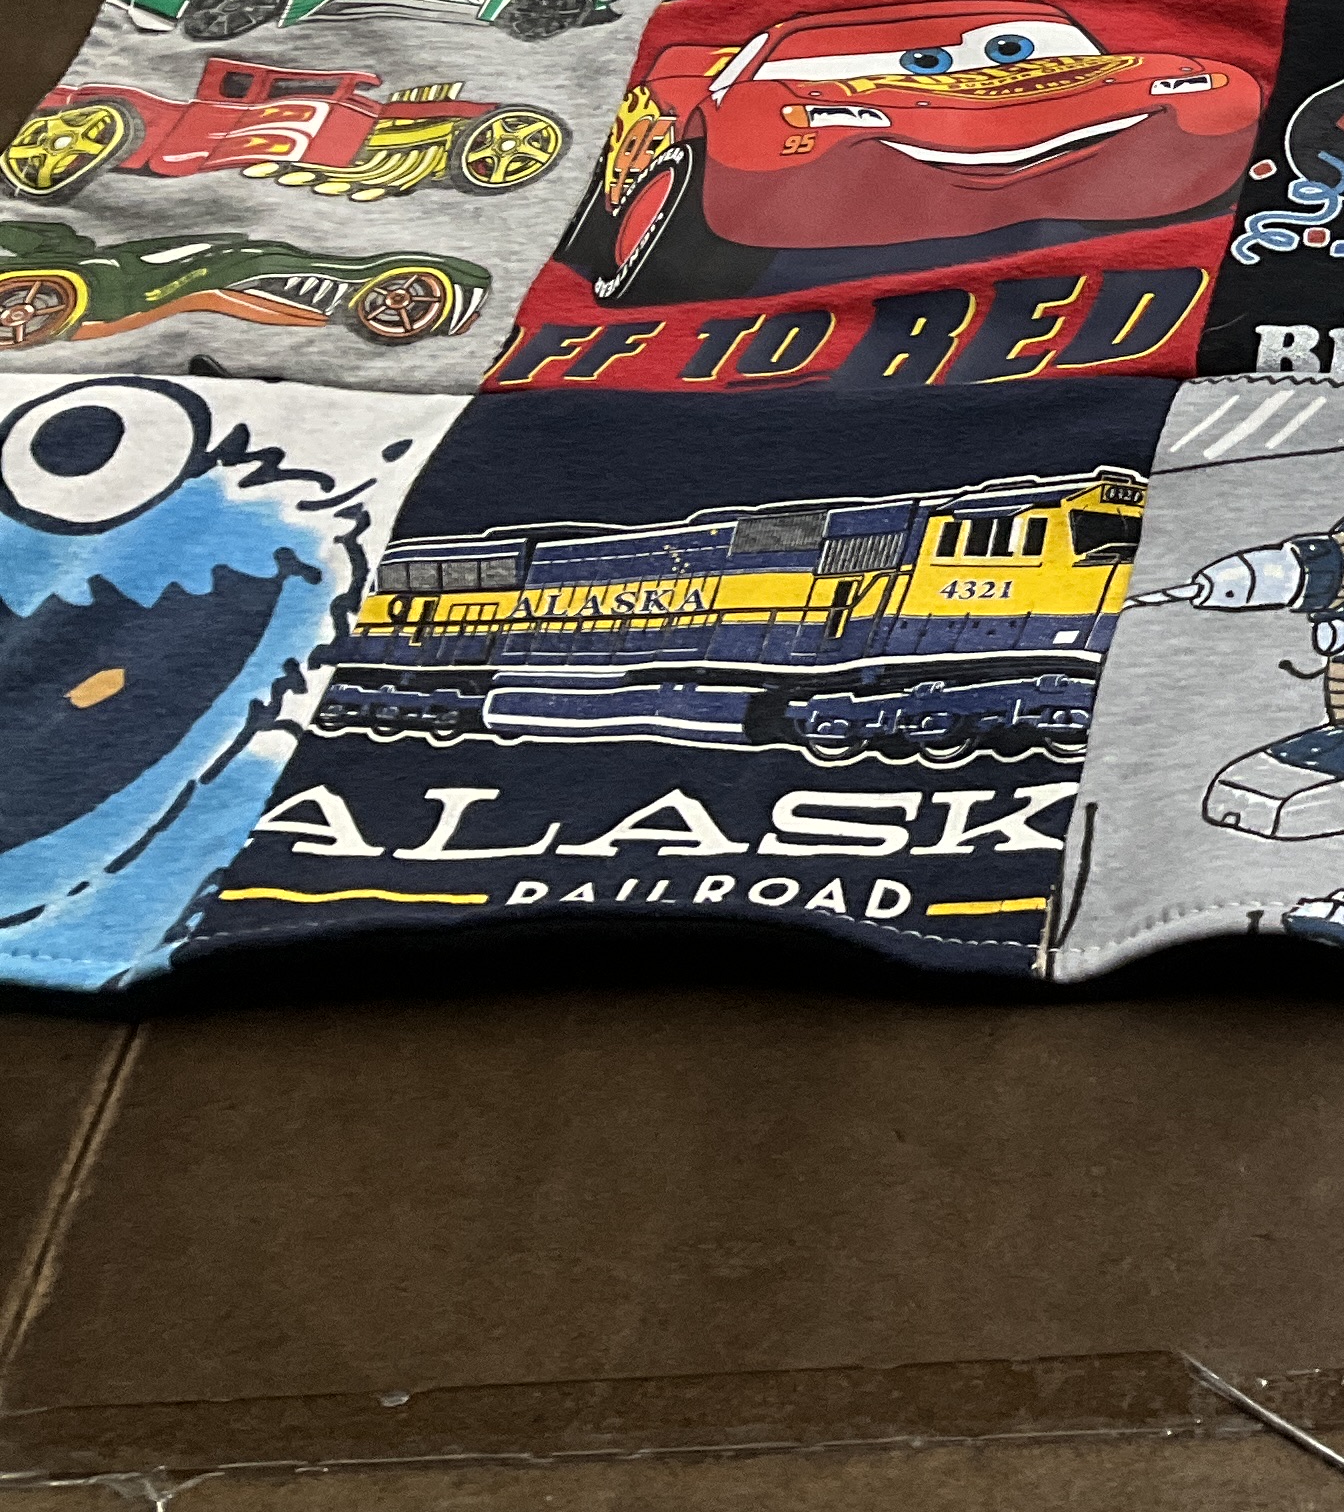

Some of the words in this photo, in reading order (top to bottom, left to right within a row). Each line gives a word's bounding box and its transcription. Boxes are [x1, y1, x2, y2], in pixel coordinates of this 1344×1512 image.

[780, 131, 818, 157] 95
[482, 318, 667, 387] FF
[682, 308, 838, 385] TO
[506, 588, 709, 620] ALASKA
[939, 579, 1014, 601] 4321
[243, 783, 1079, 861] ALASK
